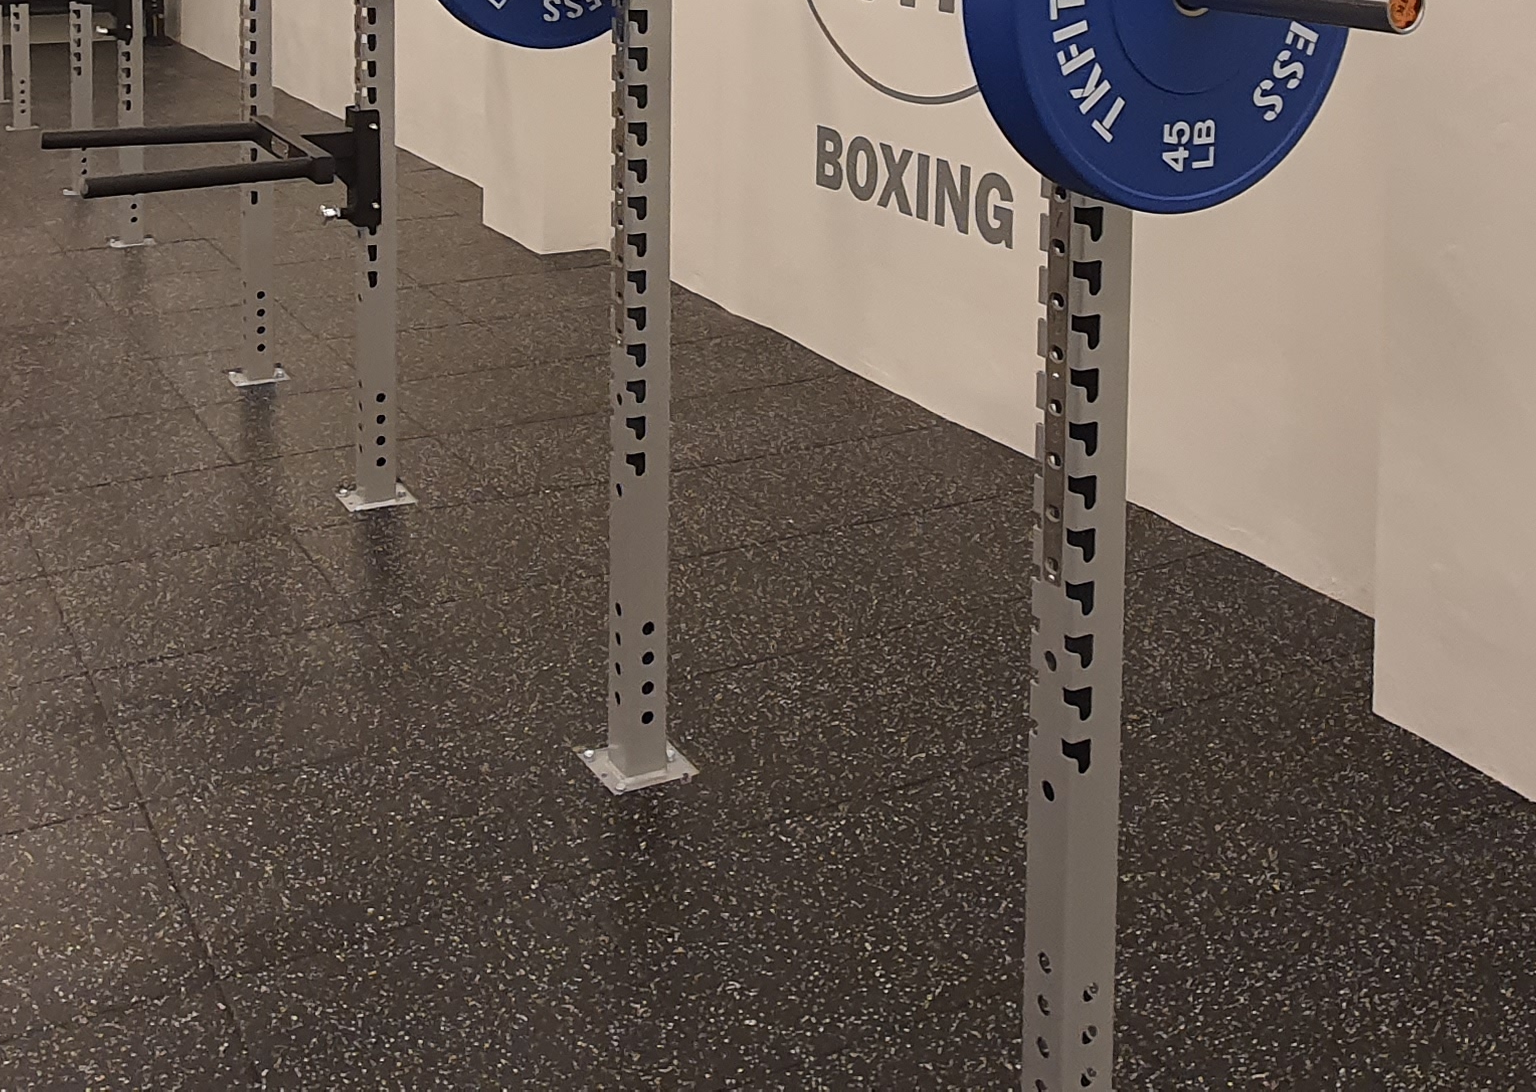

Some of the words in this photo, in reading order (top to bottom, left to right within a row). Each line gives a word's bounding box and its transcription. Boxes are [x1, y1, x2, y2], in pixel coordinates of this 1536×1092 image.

[1162, 120, 1191, 172] 45
[1192, 118, 1216, 169] LB
[816, 125, 1014, 250] BOXING
